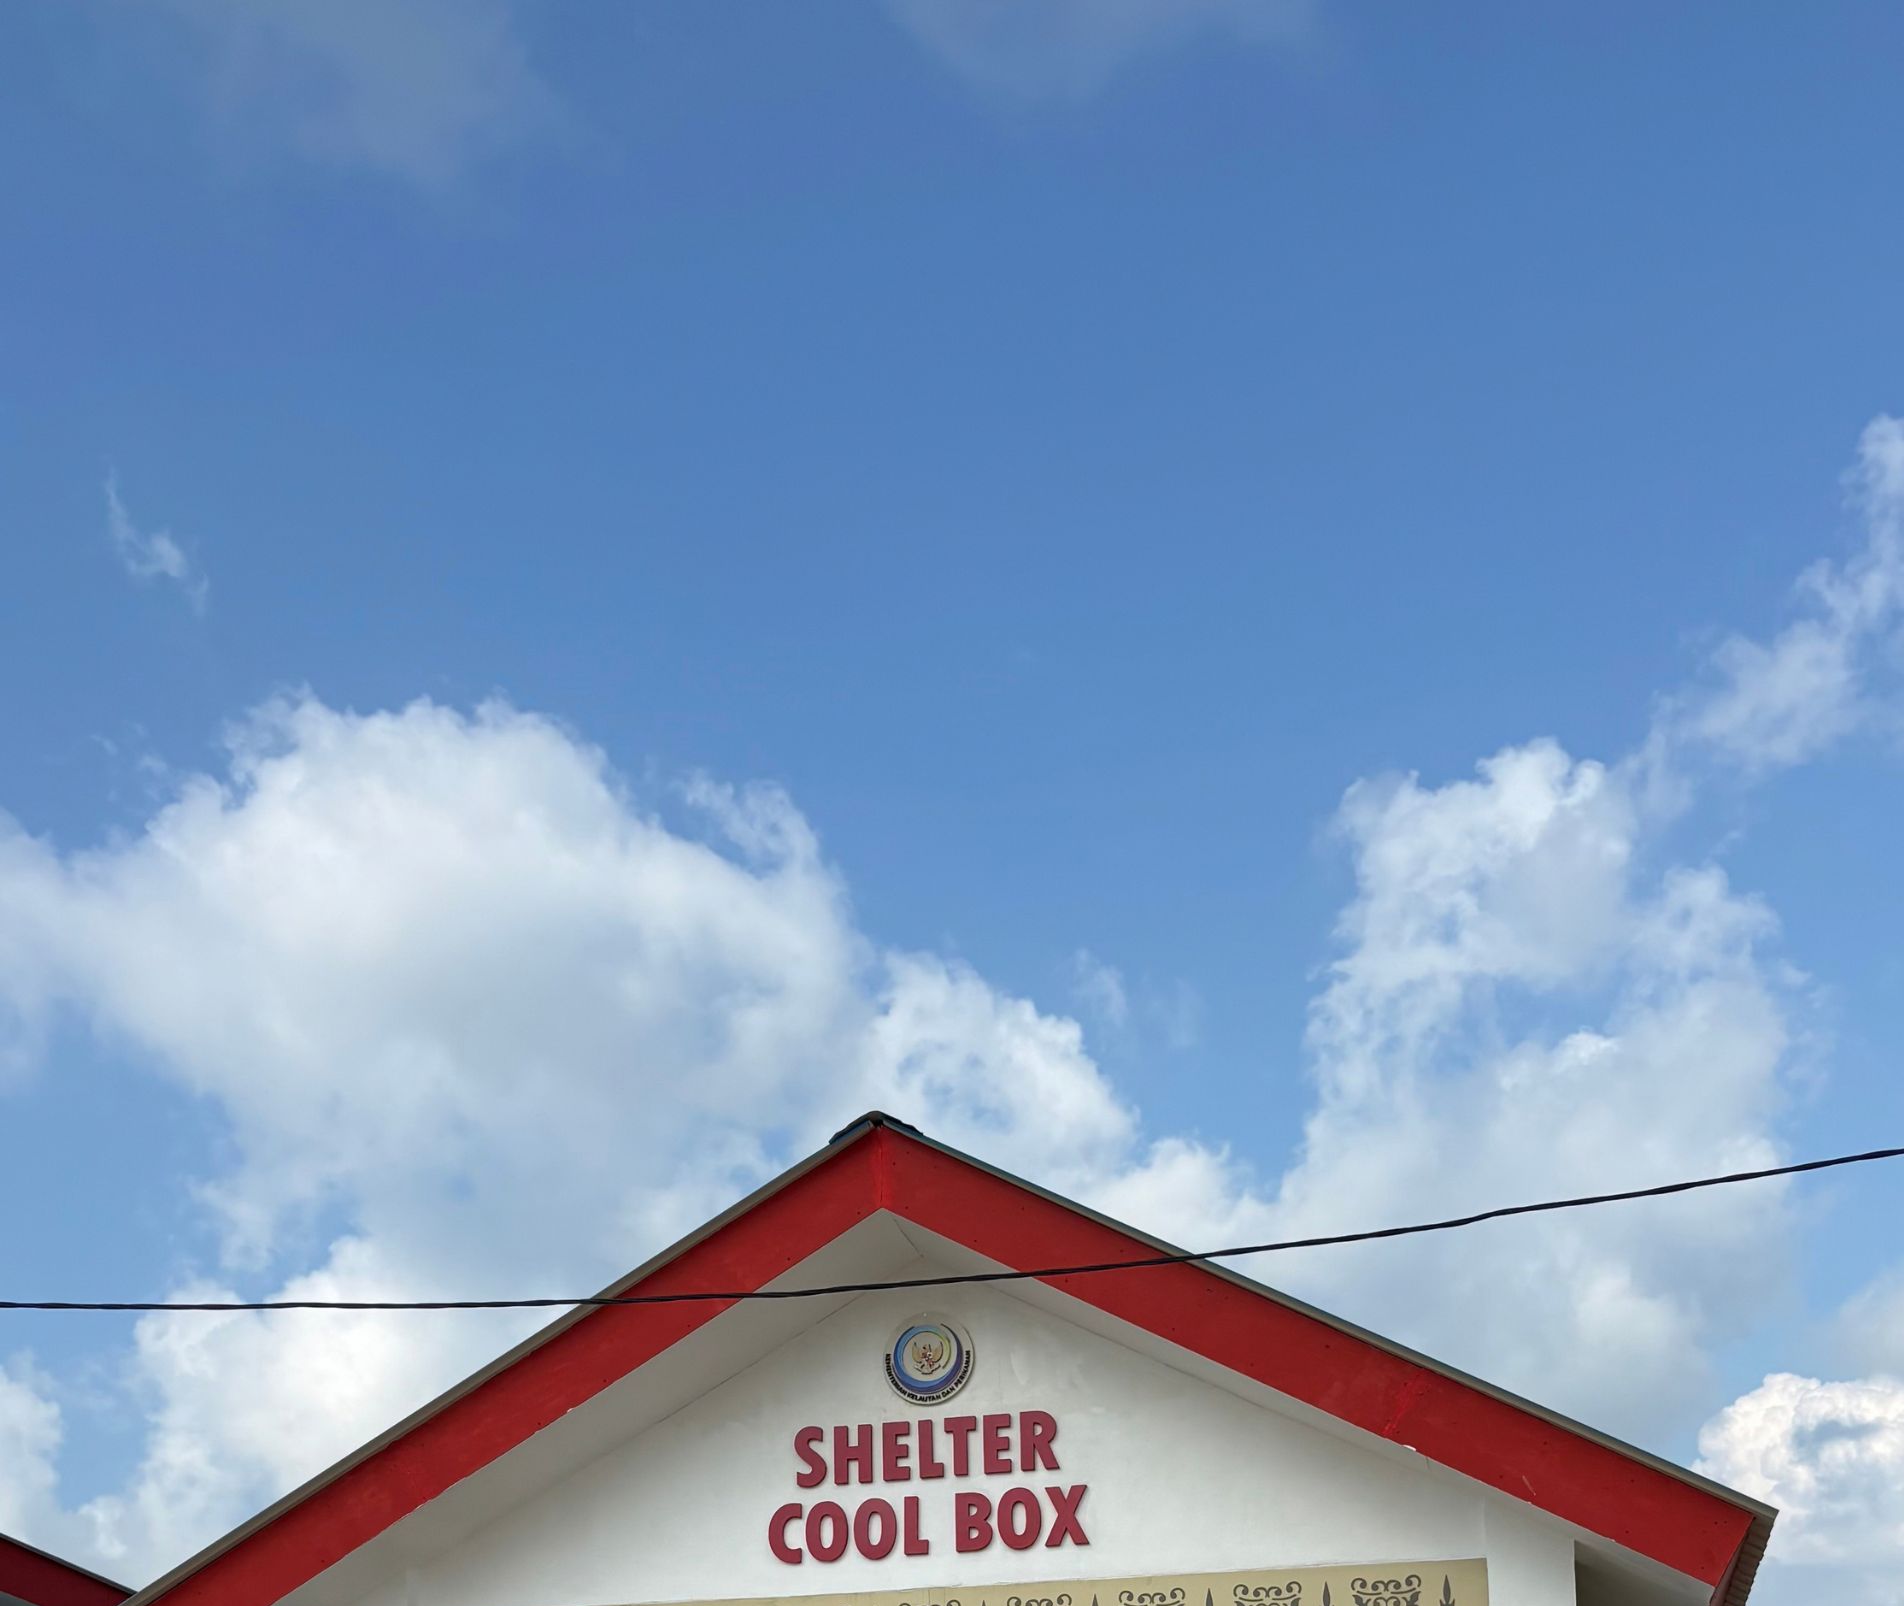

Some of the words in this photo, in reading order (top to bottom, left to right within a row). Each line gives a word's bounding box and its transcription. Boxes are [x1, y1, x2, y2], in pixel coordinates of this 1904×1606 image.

[906, 1393, 942, 1402] KELAUTAN
[942, 1388, 956, 1398] DAN
[954, 1350, 970, 1388] PERIKANAN
[793, 1410, 1060, 1488] SHELTER
[768, 1496, 929, 1564] COOL
[954, 1484, 1090, 1553] BOX
